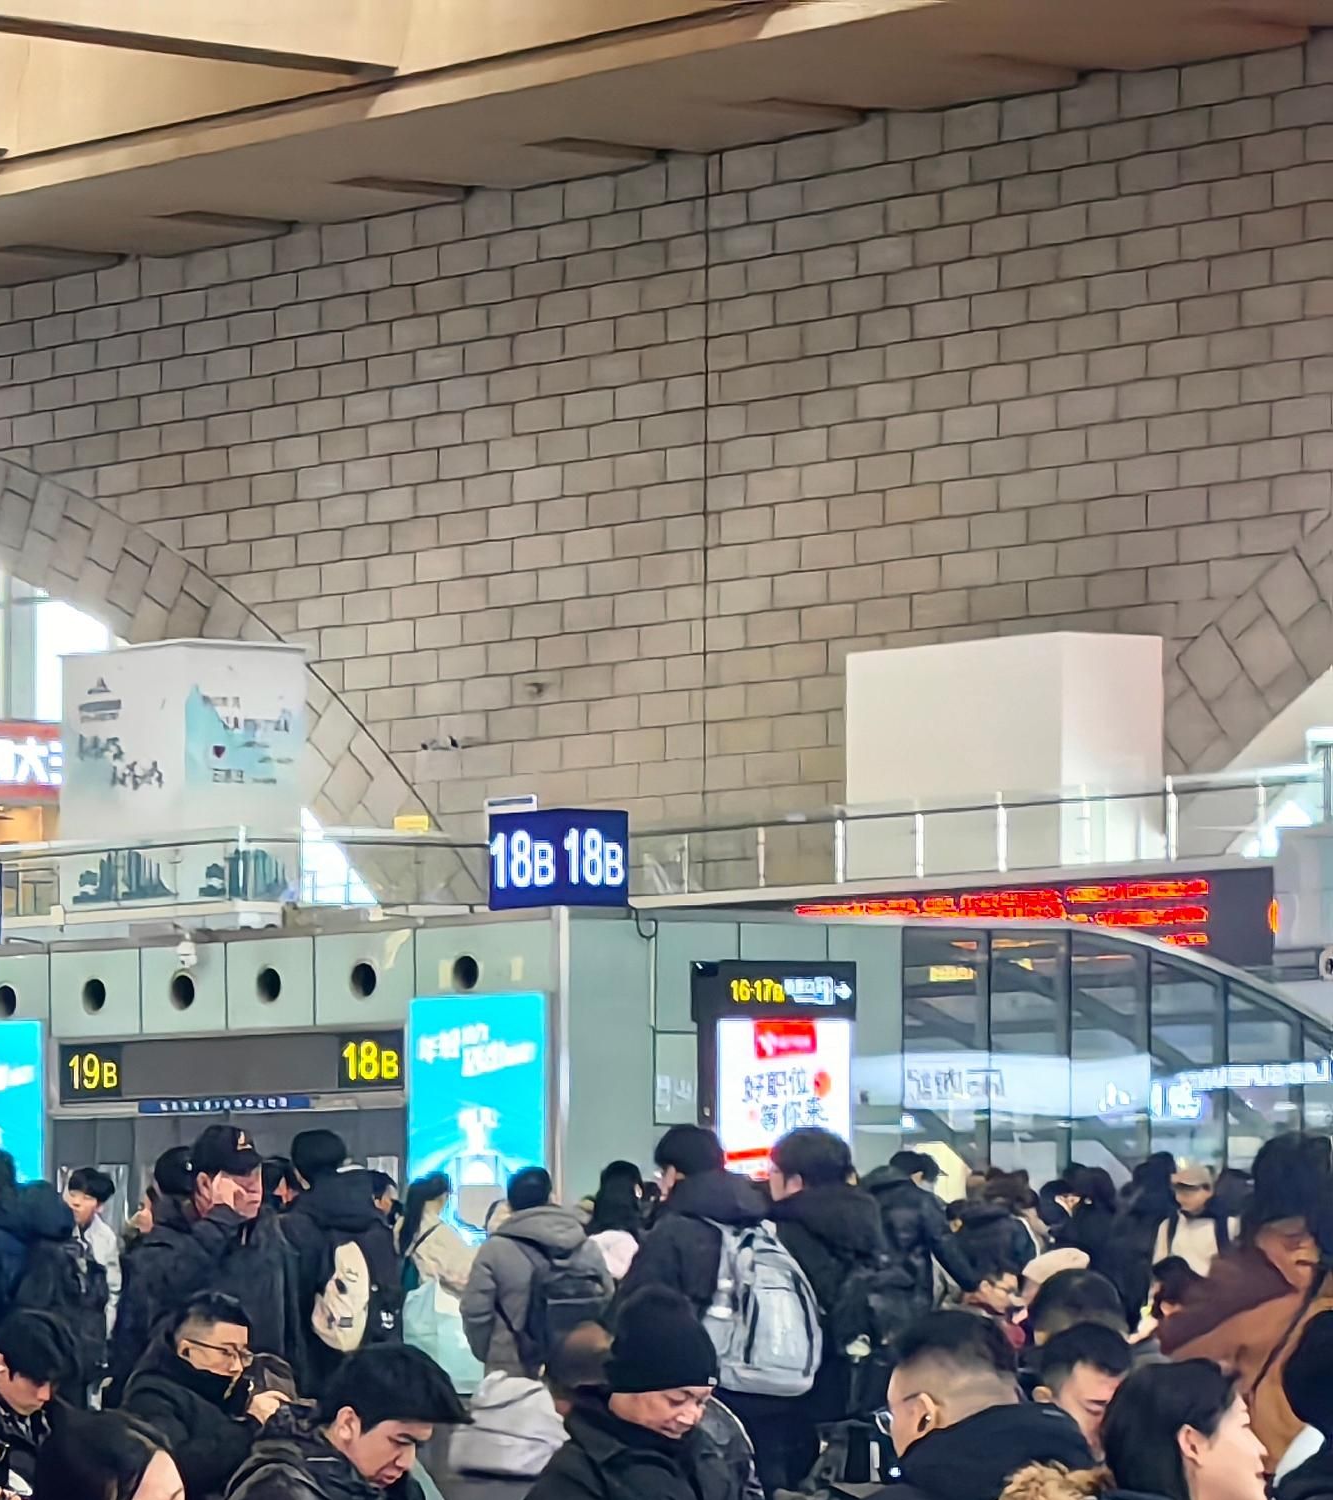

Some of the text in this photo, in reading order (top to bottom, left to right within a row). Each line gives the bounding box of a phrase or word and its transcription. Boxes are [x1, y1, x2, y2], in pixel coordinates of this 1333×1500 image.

[490, 830, 555, 889] 18B
[564, 828, 625, 886] 18B
[68, 1053, 118, 1090] 19B
[342, 1040, 399, 1081] 18B
